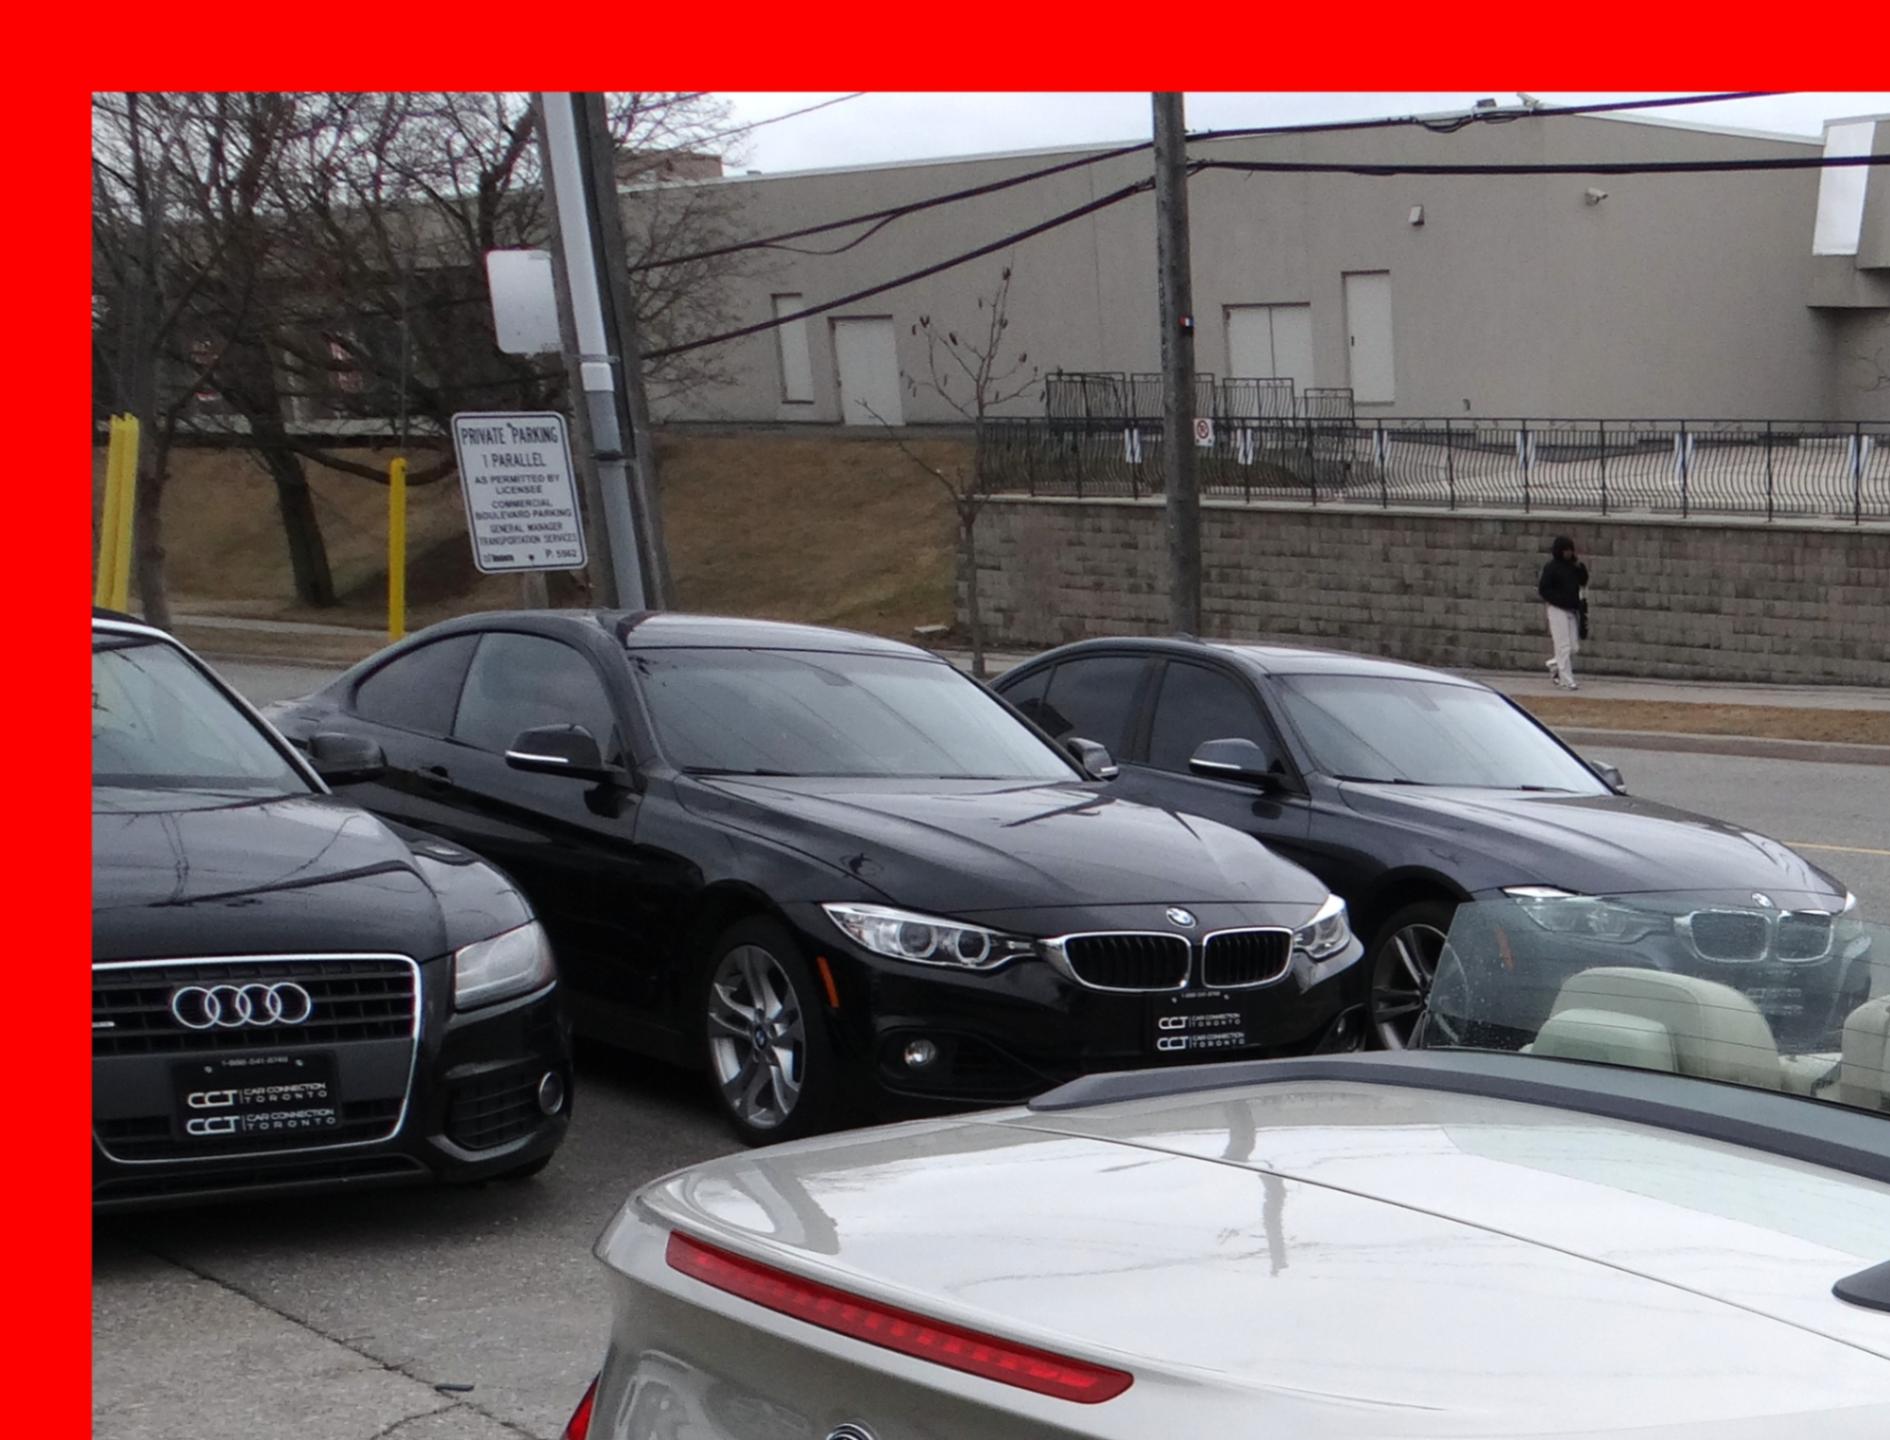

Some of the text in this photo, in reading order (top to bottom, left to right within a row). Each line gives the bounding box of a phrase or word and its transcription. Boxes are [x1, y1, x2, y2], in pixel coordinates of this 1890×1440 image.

[461, 426, 558, 445] PRIVATE PARKING
[491, 452, 547, 468] PARALLEL
[475, 473, 560, 485] AS PERMITTED BY
[495, 485, 543, 495] LICENSEE
[491, 498, 553, 509] COMMERCIAL
[475, 508, 572, 520] BOULEVARD PARKING
[490, 522, 563, 534] GENERAL MANAGER
[479, 533, 577, 546] TRANSPORTATION SERVICES
[1158, 1016, 1188, 1030] CCT
[1156, 1035, 1189, 1051] CCT
[187, 1082, 326, 1108] CCT CAR CONNECTION
[244, 1090, 327, 1104] TORONTO
[187, 1107, 334, 1135] CCT CAR CONNECTION
[248, 1116, 336, 1131] TORONTO
